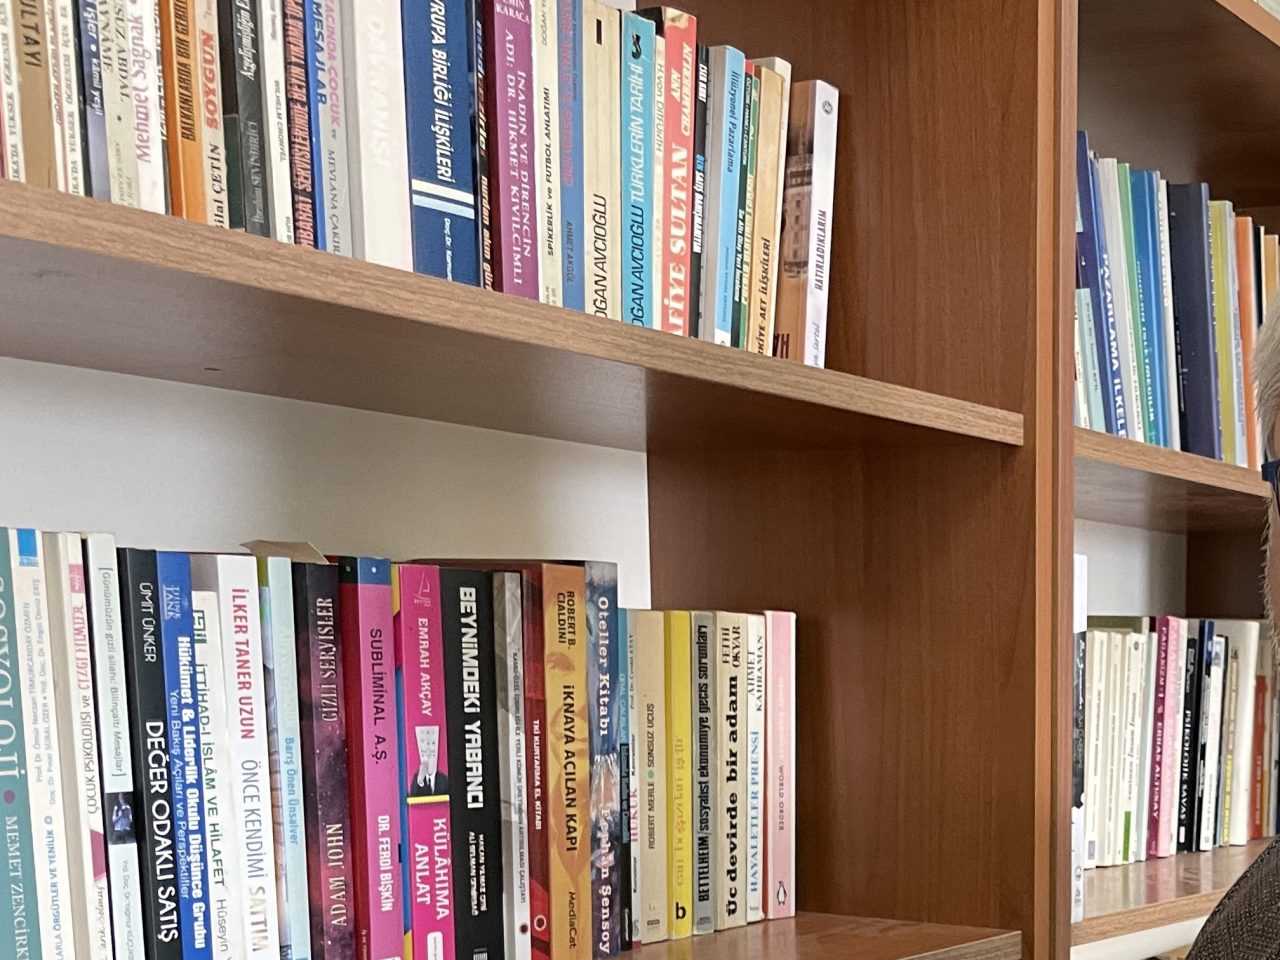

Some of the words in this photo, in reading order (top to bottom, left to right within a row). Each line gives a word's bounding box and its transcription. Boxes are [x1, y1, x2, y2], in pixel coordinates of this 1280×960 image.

[178, 61, 196, 141] BALKANLARDA
[200, 30, 219, 130] SOYGUN
[516, 71, 527, 135] İNADIN
[206, 144, 225, 193] ÇETİN
[507, 109, 520, 178] HİKMET
[519, 141, 529, 164] VE
[629, 115, 645, 203] TÜRKLERİN
[520, 171, 533, 256] DİRENCİN
[669, 145, 689, 256] SULTAN
[510, 185, 523, 283] KIVILCIMLI
[593, 195, 608, 275] AVCIOĞLU
[631, 205, 646, 281] AVCIOĞLU
[814, 210, 827, 291] HATIRLADIKLARIM
[139, 582, 156, 616] ÜMİT
[231, 588, 248, 640] İLKER
[557, 592, 567, 644] CIALDINI
[566, 590, 577, 635] ROBERT
[140, 617, 157, 662] ÜNKER
[417, 617, 430, 669] EMRAH
[459, 586, 481, 714] BEYNİMDEKİ
[597, 596, 609, 667] Oteller
[177, 637, 194, 704] Hükümet
[234, 641, 252, 695] TANER
[369, 628, 389, 726] SUBLİMİNAL
[420, 672, 433, 717] AKÇAY
[169, 689, 180, 717] Yeni
[181, 709, 195, 722] &
[238, 696, 256, 739] UZUN
[563, 684, 577, 745] İKNAYA
[599, 673, 611, 736] Kitabı
[726, 675, 738, 743] adam
[145, 721, 170, 794] DEĞER
[171, 720, 182, 756] Bakış
[284, 738, 296, 767] Barış
[371, 734, 388, 765] A.Ş.
[464, 719, 484, 809] YABANCI
[647, 731, 655, 768] SONSUZ
[750, 731, 760, 786] PRENSİ
[241, 760, 261, 804] ÖNCE
[285, 768, 297, 796] Önen
[563, 749, 578, 808] AÇILAN
[726, 748, 738, 783] bir
[176, 805, 184, 818] ve
[186, 784, 200, 830] Okulu
[206, 796, 219, 817] VE
[288, 799, 299, 845] Ünsalver
[630, 788, 639, 842] HUKUK
[647, 781, 656, 812] MERLE
[5, 815, 23, 878] MEMET
[151, 802, 174, 880] ODAKLI
[243, 808, 269, 879] KENDİMİ
[325, 822, 345, 868] JOHN
[377, 816, 391, 834] DR.
[565, 812, 578, 852] KAPI
[648, 814, 656, 849] ROBERT
[726, 791, 738, 883] devirde
[750, 789, 760, 892] HAYALETLER
[187, 834, 205, 899] Düşünce
[208, 823, 226, 887] HİLAFET
[378, 837, 393, 871] FERDİ
[414, 844, 431, 905] ANLAT
[433, 818, 451, 920] KÜLÂHIMA
[157, 886, 179, 943] SATIŞ
[328, 875, 348, 927] ADAM
[379, 872, 395, 912] BİŞKİN
[192, 902, 206, 949] Grubu
[216, 899, 230, 952] Hüseyin
[568, 891, 578, 950] MediaCat
